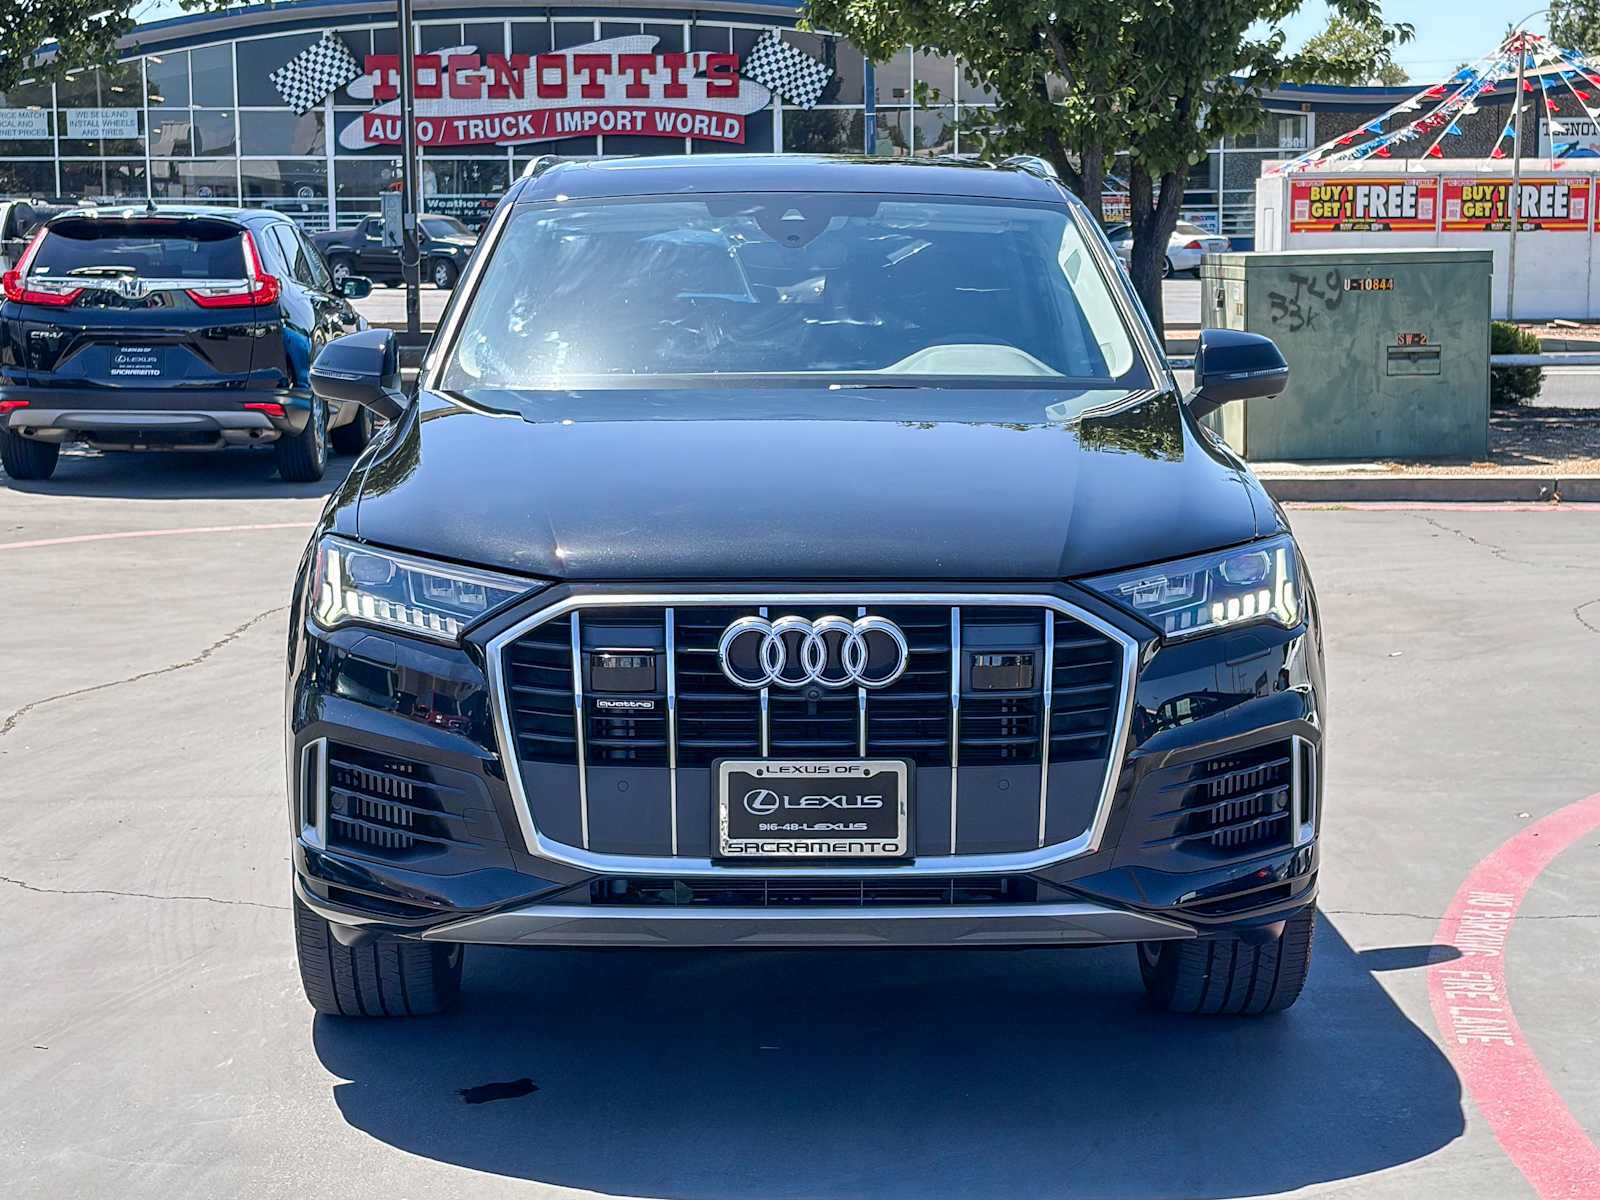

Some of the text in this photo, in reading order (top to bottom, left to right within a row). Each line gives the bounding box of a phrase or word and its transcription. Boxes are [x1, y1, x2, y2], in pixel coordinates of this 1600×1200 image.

[364, 53, 740, 100] TOGNOTTI'S
[368, 118, 434, 142] AUO
[453, 114, 535, 141] TRUCK
[555, 110, 647, 132] IMPORT
[655, 111, 740, 139] WORLD
[1310, 186, 1354, 201] BUY 1
[1462, 185, 1506, 201] BUY 1
[1356, 185, 1417, 218] FREE
[1311, 202, 1341, 218] GET
[1345, 202, 1352, 217] 1
[1463, 202, 1504, 217] GET 1
[1343, 278, 1394, 292] U-10844
[1397, 333, 1428, 345] SW-2
[766, 765, 861, 774] LEXUS OF
[783, 795, 884, 809] LEXUS
[758, 822, 868, 832] 916-48-LEXUS
[728, 842, 899, 853] SACRAMENTO
[1438, 890, 1516, 1047] NO PARKING FIRE LANE
